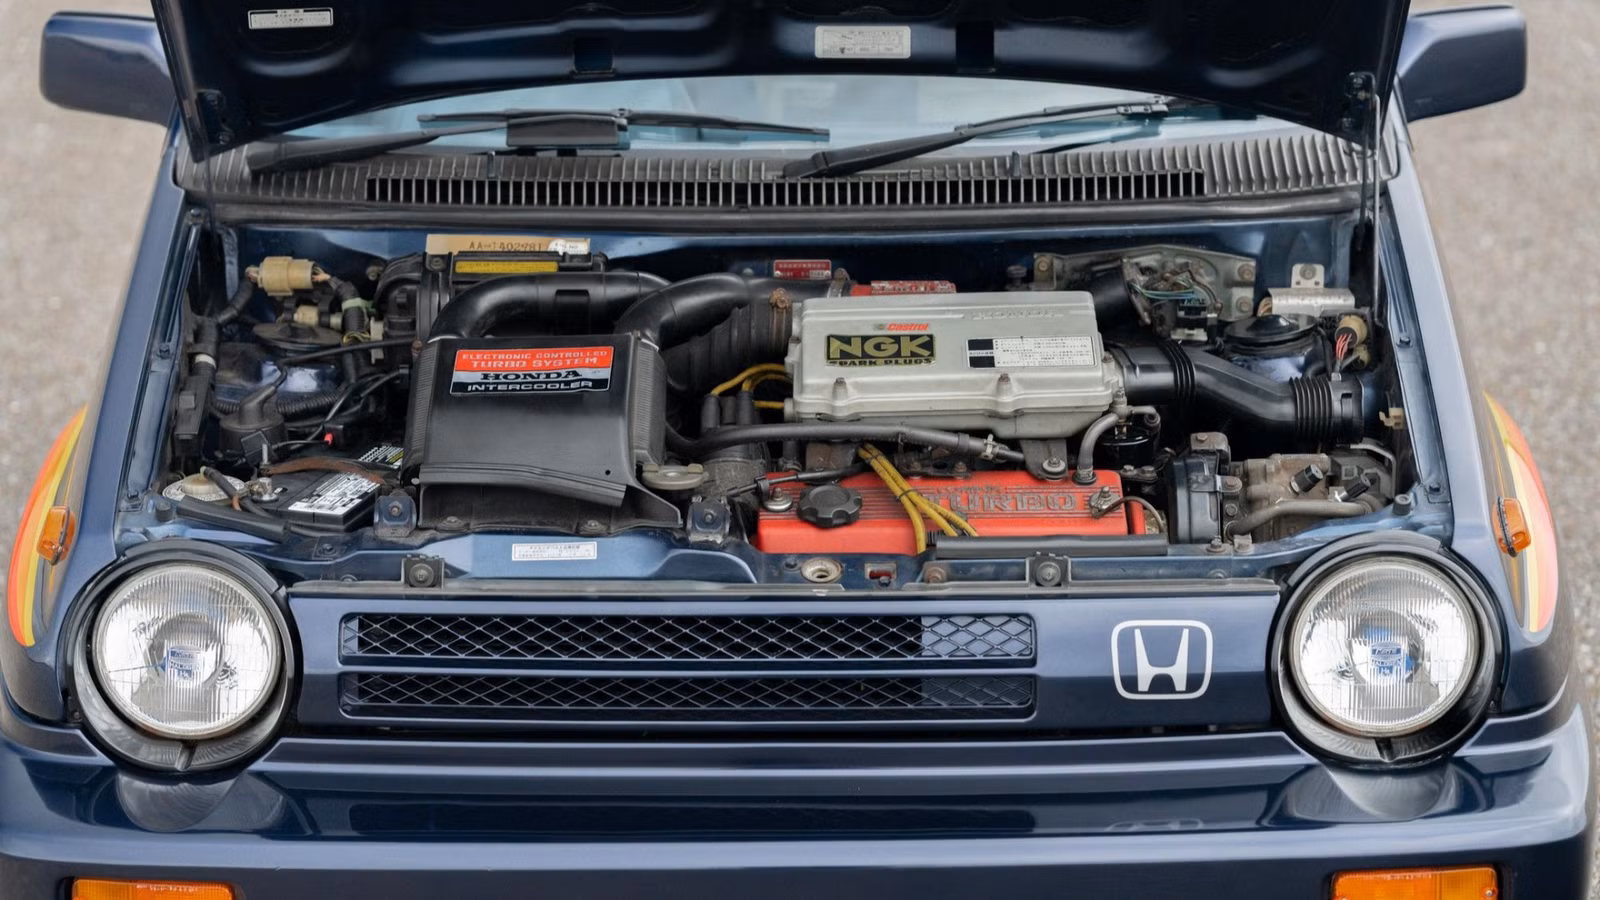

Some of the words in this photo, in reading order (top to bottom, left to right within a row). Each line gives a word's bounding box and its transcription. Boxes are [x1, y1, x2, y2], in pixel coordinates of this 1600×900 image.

[829, 335, 931, 358] NGK
[536, 350, 608, 358] CONTROLLED
[472, 360, 527, 368] TURBO
[532, 357, 598, 368] SYSTEM
[481, 370, 582, 381] HONDA
[468, 381, 593, 391] INTERCOOLER
[927, 493, 1077, 512] TURBO
